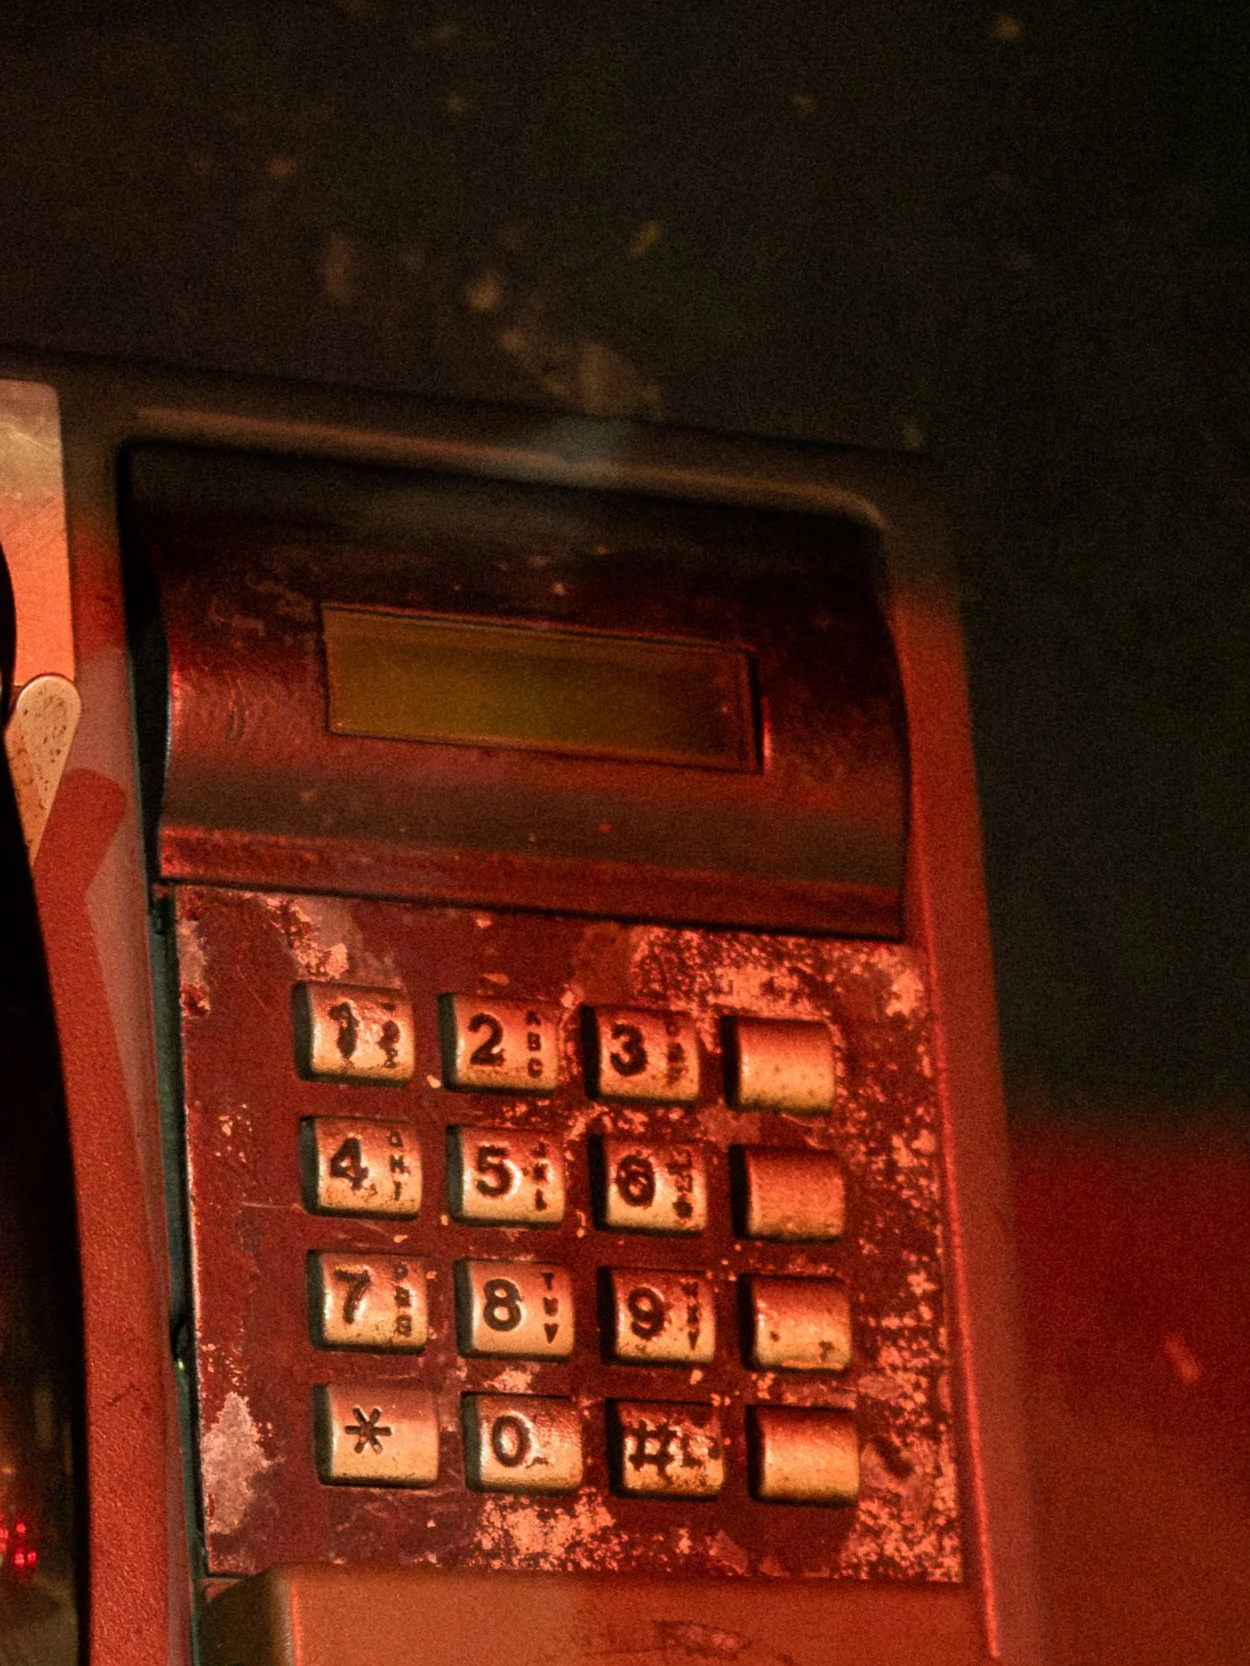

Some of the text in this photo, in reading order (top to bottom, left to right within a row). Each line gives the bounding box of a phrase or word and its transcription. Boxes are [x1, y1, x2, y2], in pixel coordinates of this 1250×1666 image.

[469, 1013, 505, 1066] 2
[610, 1023, 648, 1077] 3
[330, 1137, 369, 1190] 4
[477, 1144, 514, 1197] 5
[616, 1151, 655, 1208] 6
[334, 1267, 371, 1325] 7
[483, 1278, 523, 1332] 8
[628, 1286, 665, 1340] 9
[492, 1415, 529, 1468] 0
